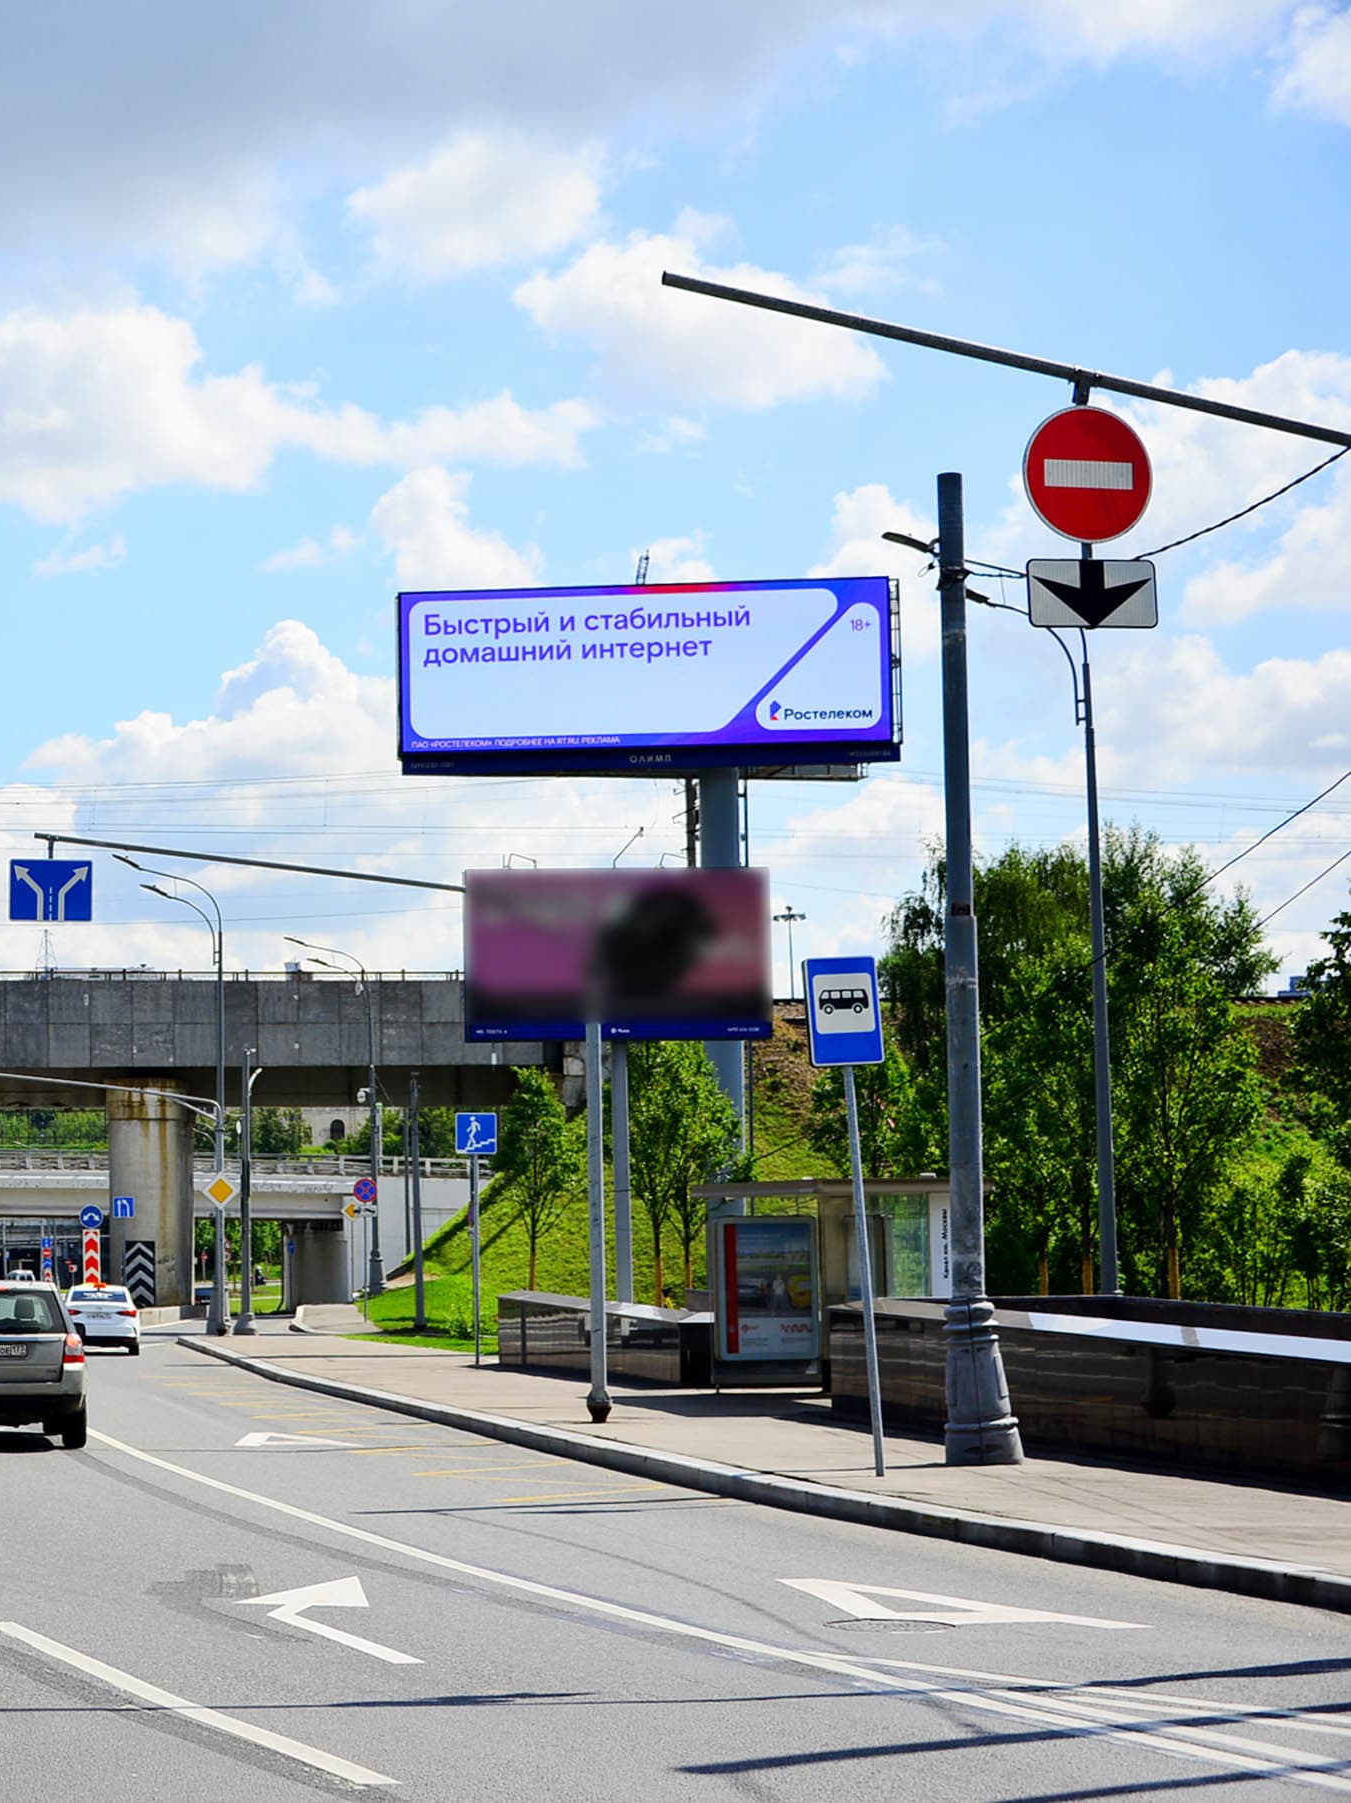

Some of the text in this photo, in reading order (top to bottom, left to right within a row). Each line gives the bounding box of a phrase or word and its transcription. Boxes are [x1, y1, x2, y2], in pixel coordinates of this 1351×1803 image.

[423, 604, 751, 640] Быстрый и стабильный
[850, 618, 872, 632] 18+
[423, 639, 713, 668] домашний интернет
[783, 707, 873, 721] Ростелеком
[411, 740, 429, 749] ПАО
[544, 736, 556, 746] НА
[581, 735, 621, 745] РЕКЛАМА
[629, 754, 672, 764] ОЛИМП
